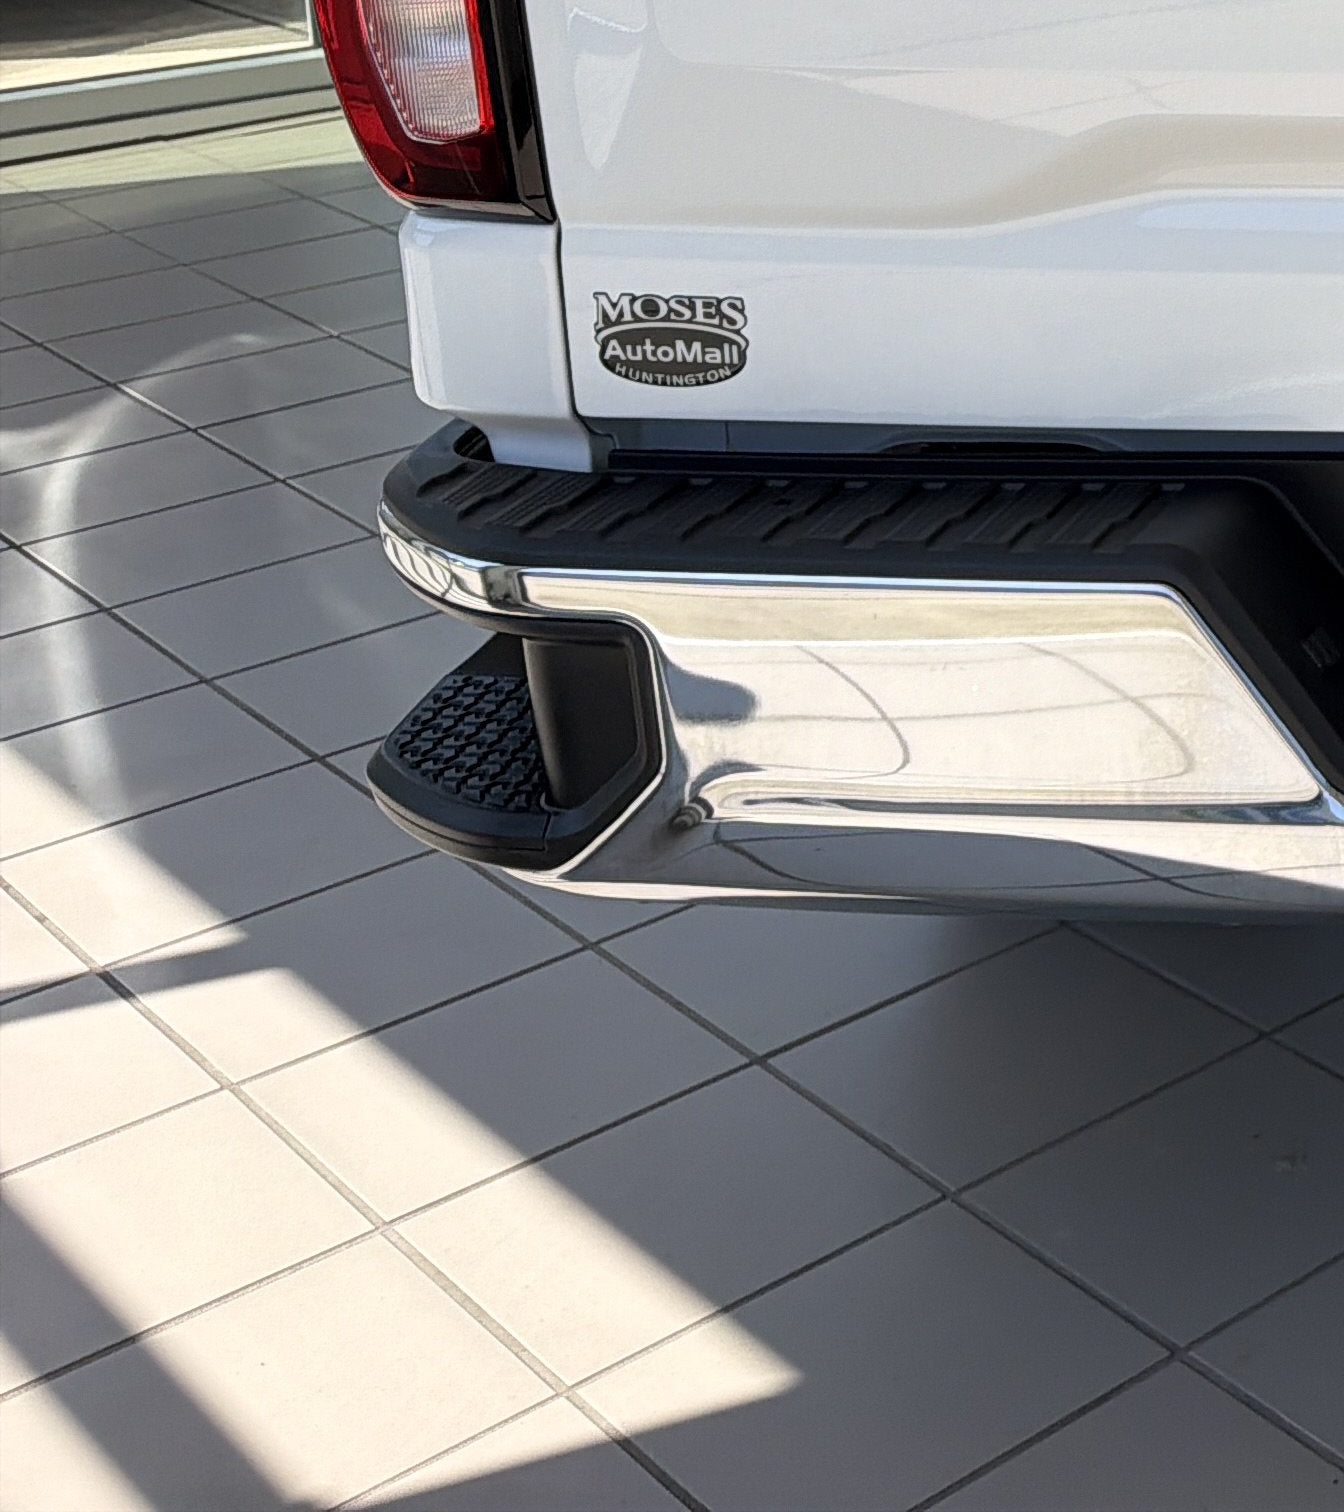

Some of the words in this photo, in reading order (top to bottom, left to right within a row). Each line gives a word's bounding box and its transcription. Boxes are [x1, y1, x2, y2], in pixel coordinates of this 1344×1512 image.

[595, 294, 745, 330] MOSES
[603, 339, 739, 364] AutoMall
[615, 363, 732, 386] HUNTINGTON
